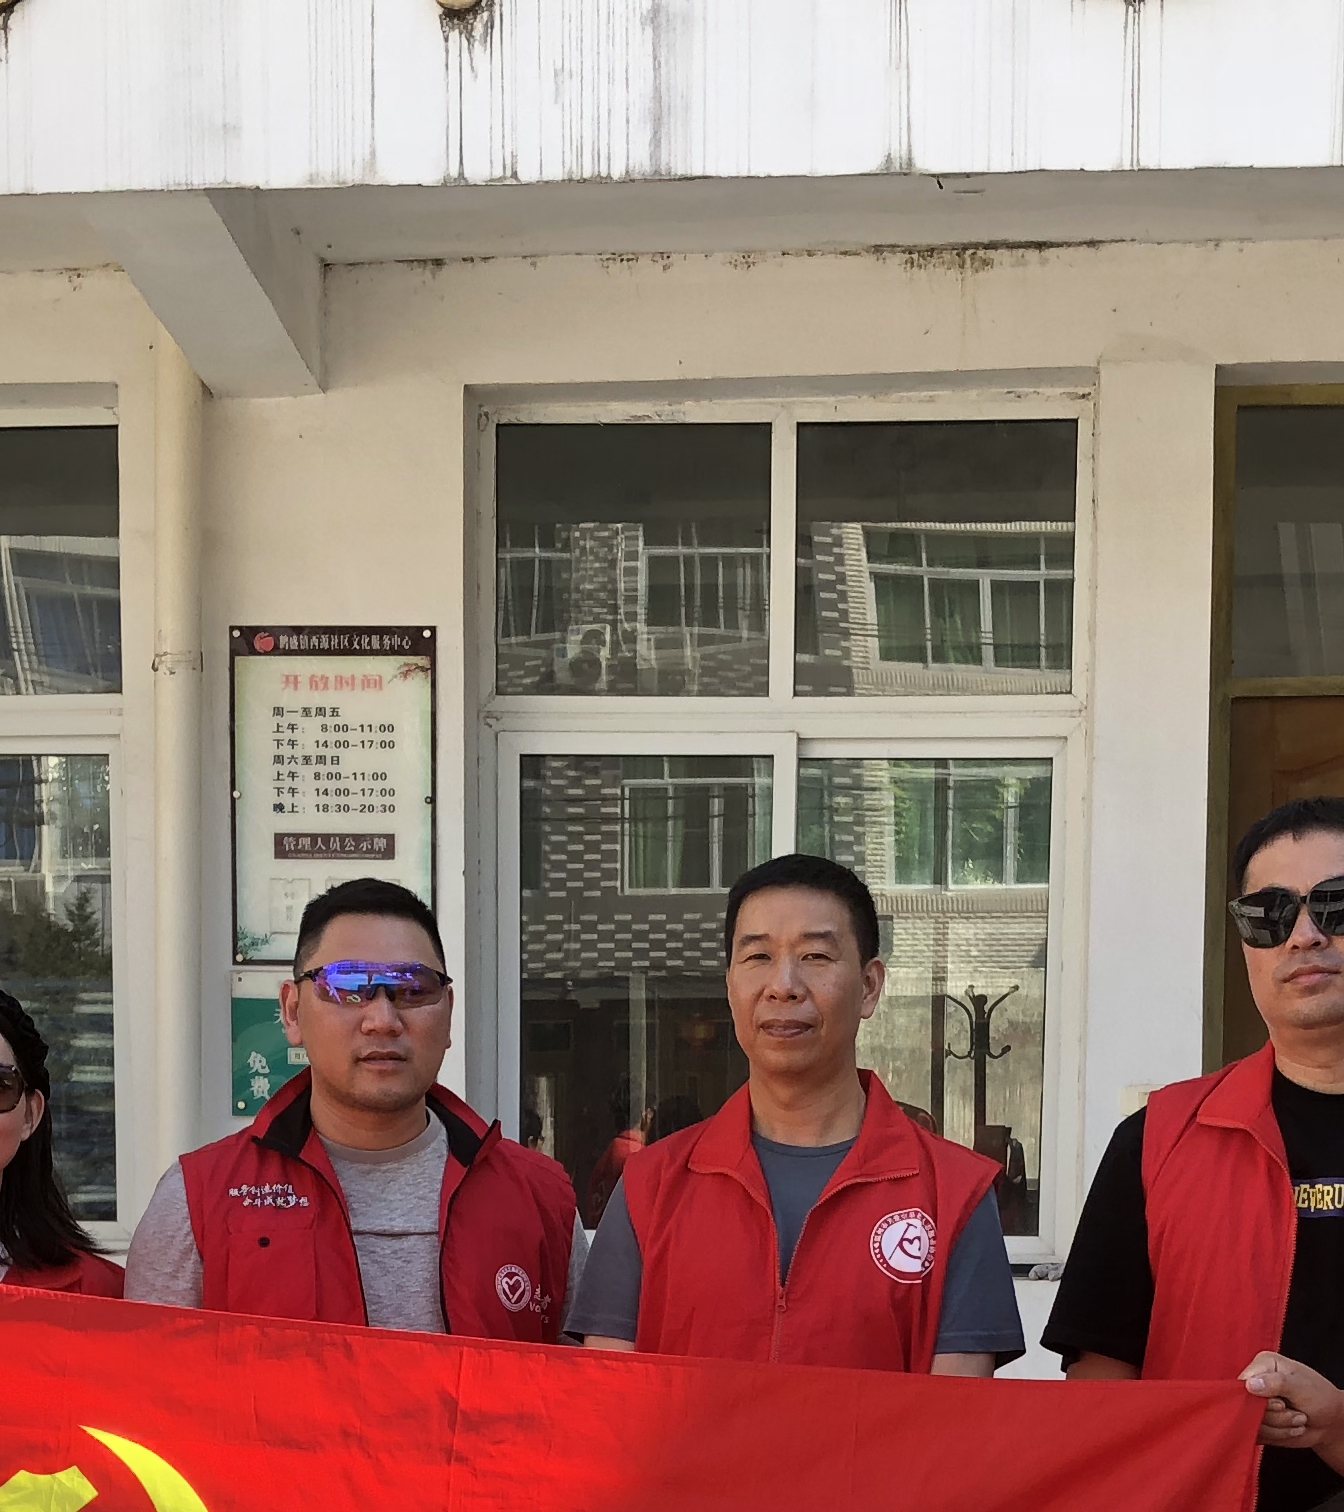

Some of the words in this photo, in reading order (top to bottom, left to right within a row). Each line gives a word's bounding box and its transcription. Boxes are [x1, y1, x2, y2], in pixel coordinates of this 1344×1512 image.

[279, 634, 412, 651] 鹤盛镇西源社区文化服务中心
[282, 673, 384, 692] 开放时间
[272, 706, 341, 718] 周一至周五
[320, 723, 395, 734] 8:00-11:00
[314, 739, 396, 750] 14:00-17:00
[272, 754, 341, 766] 周六至周日
[313, 771, 388, 782] 8:00-11:00
[314, 787, 396, 798] 14:00-17:00
[314, 803, 396, 814] 18:30-20:30
[282, 836, 388, 852] 管理人员公示牌
[247, 1050, 271, 1101] 免费
